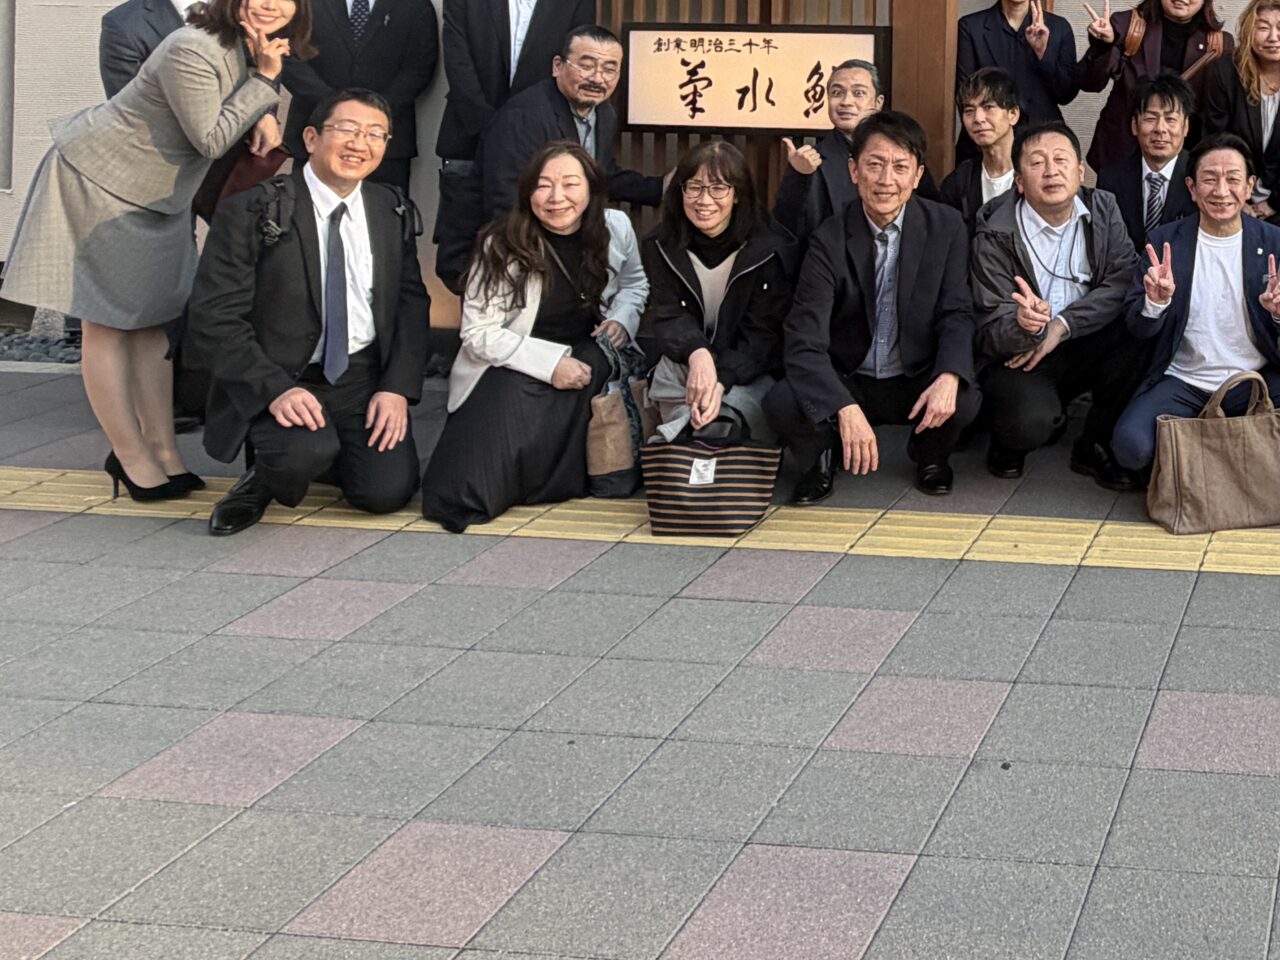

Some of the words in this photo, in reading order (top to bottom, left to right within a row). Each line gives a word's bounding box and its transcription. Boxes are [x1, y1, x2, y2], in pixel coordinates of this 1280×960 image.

[653, 37, 778, 55] 創業明治三十年
